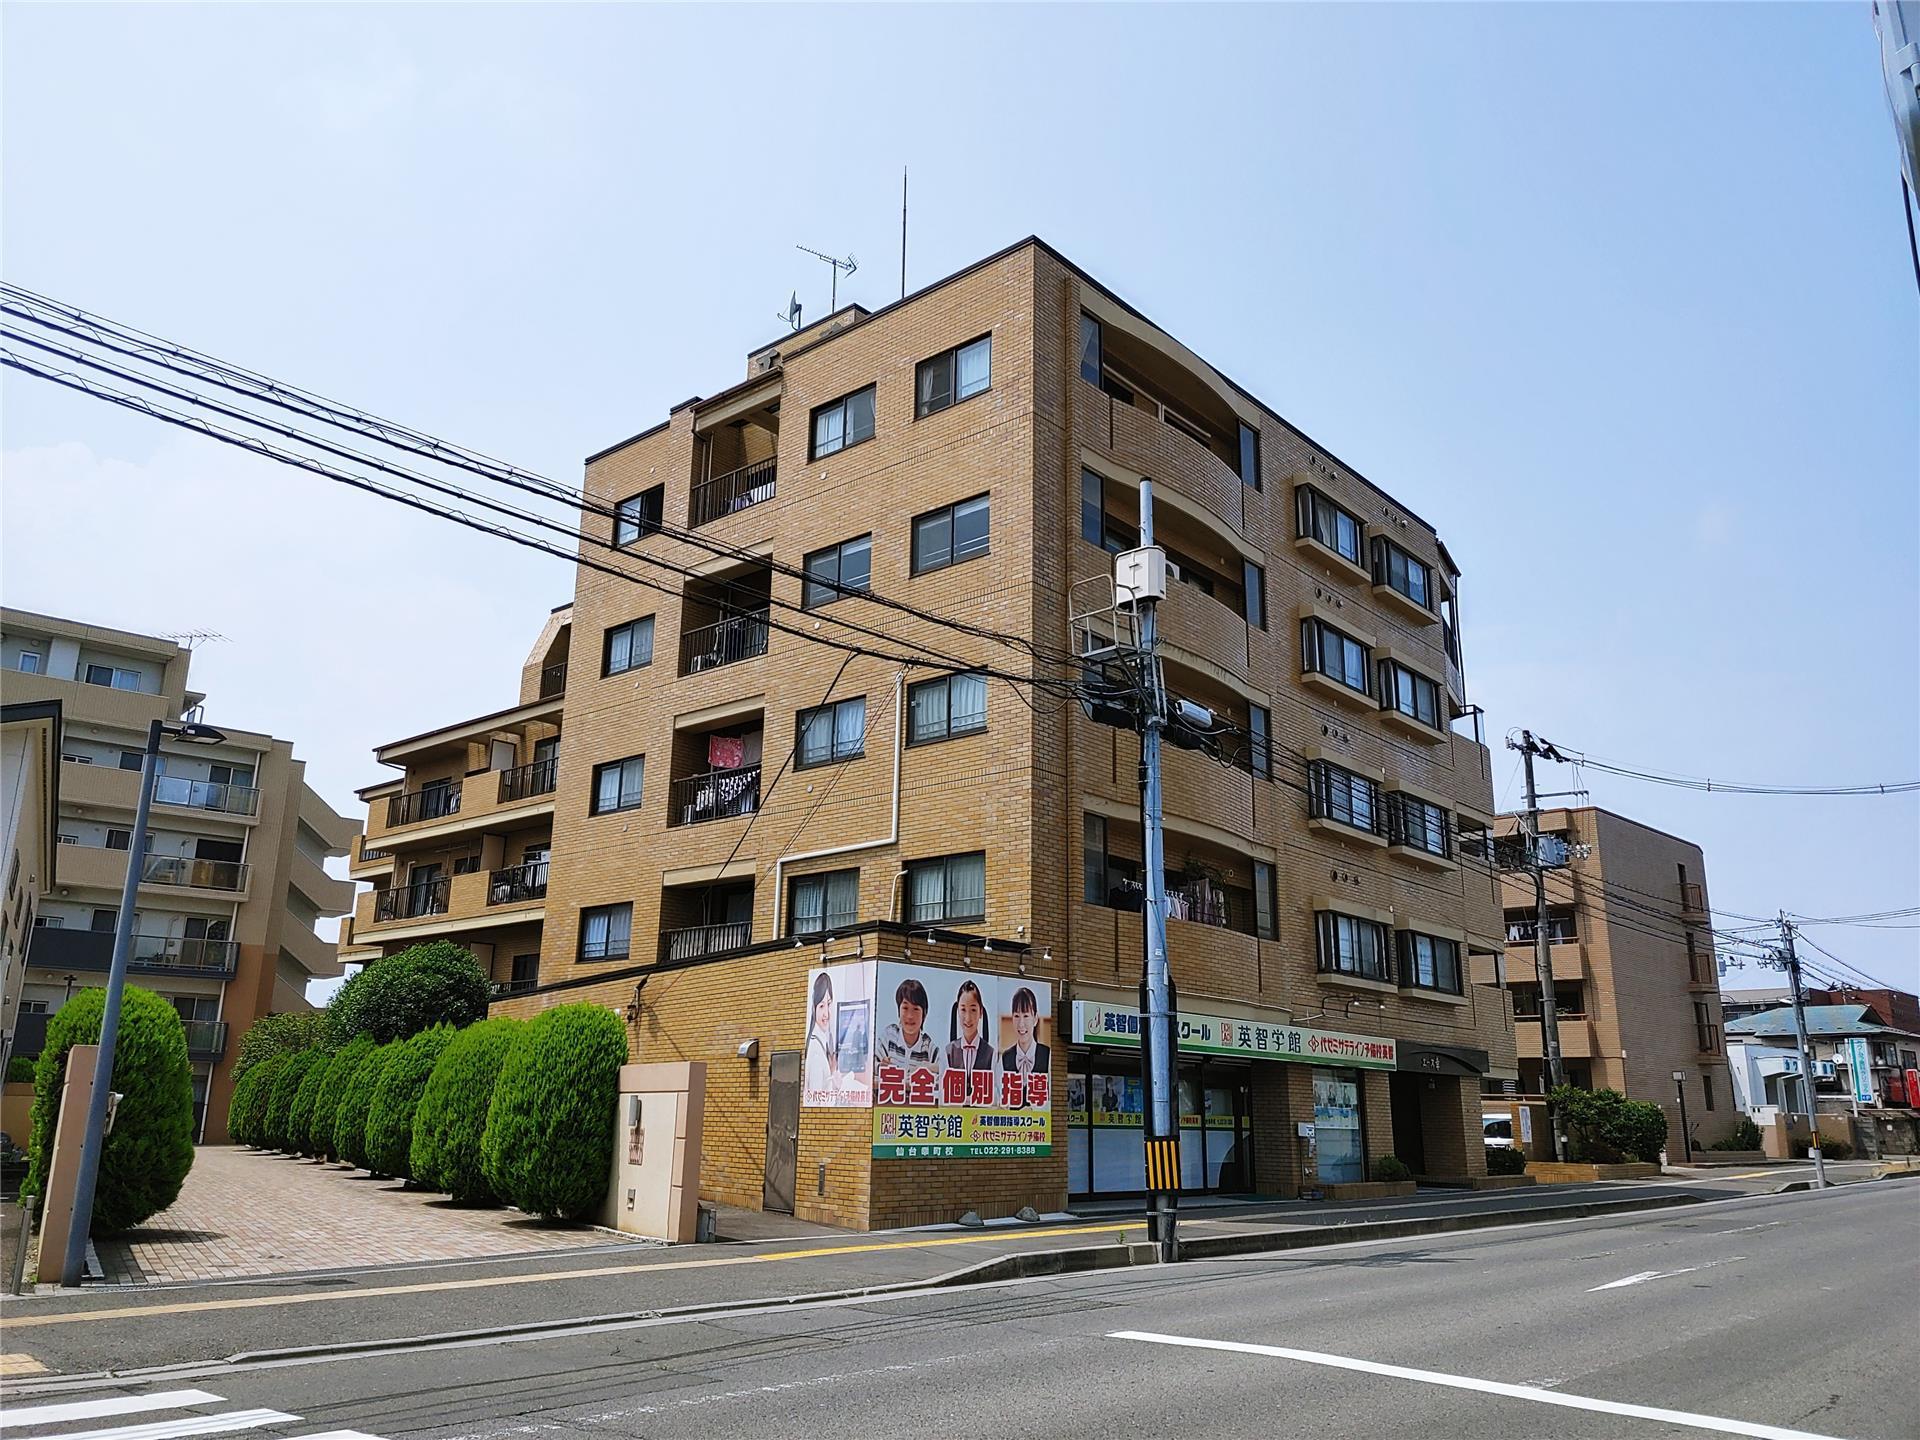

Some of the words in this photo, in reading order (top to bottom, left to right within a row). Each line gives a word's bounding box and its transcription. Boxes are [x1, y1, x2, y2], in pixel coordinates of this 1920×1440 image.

[1104, 1012, 1211, 1041] 英智個クール
[1238, 1025, 1301, 1054] 英智学館
[878, 1066, 1049, 1107] 完全個別指導
[897, 1113, 963, 1139] 英智学館
